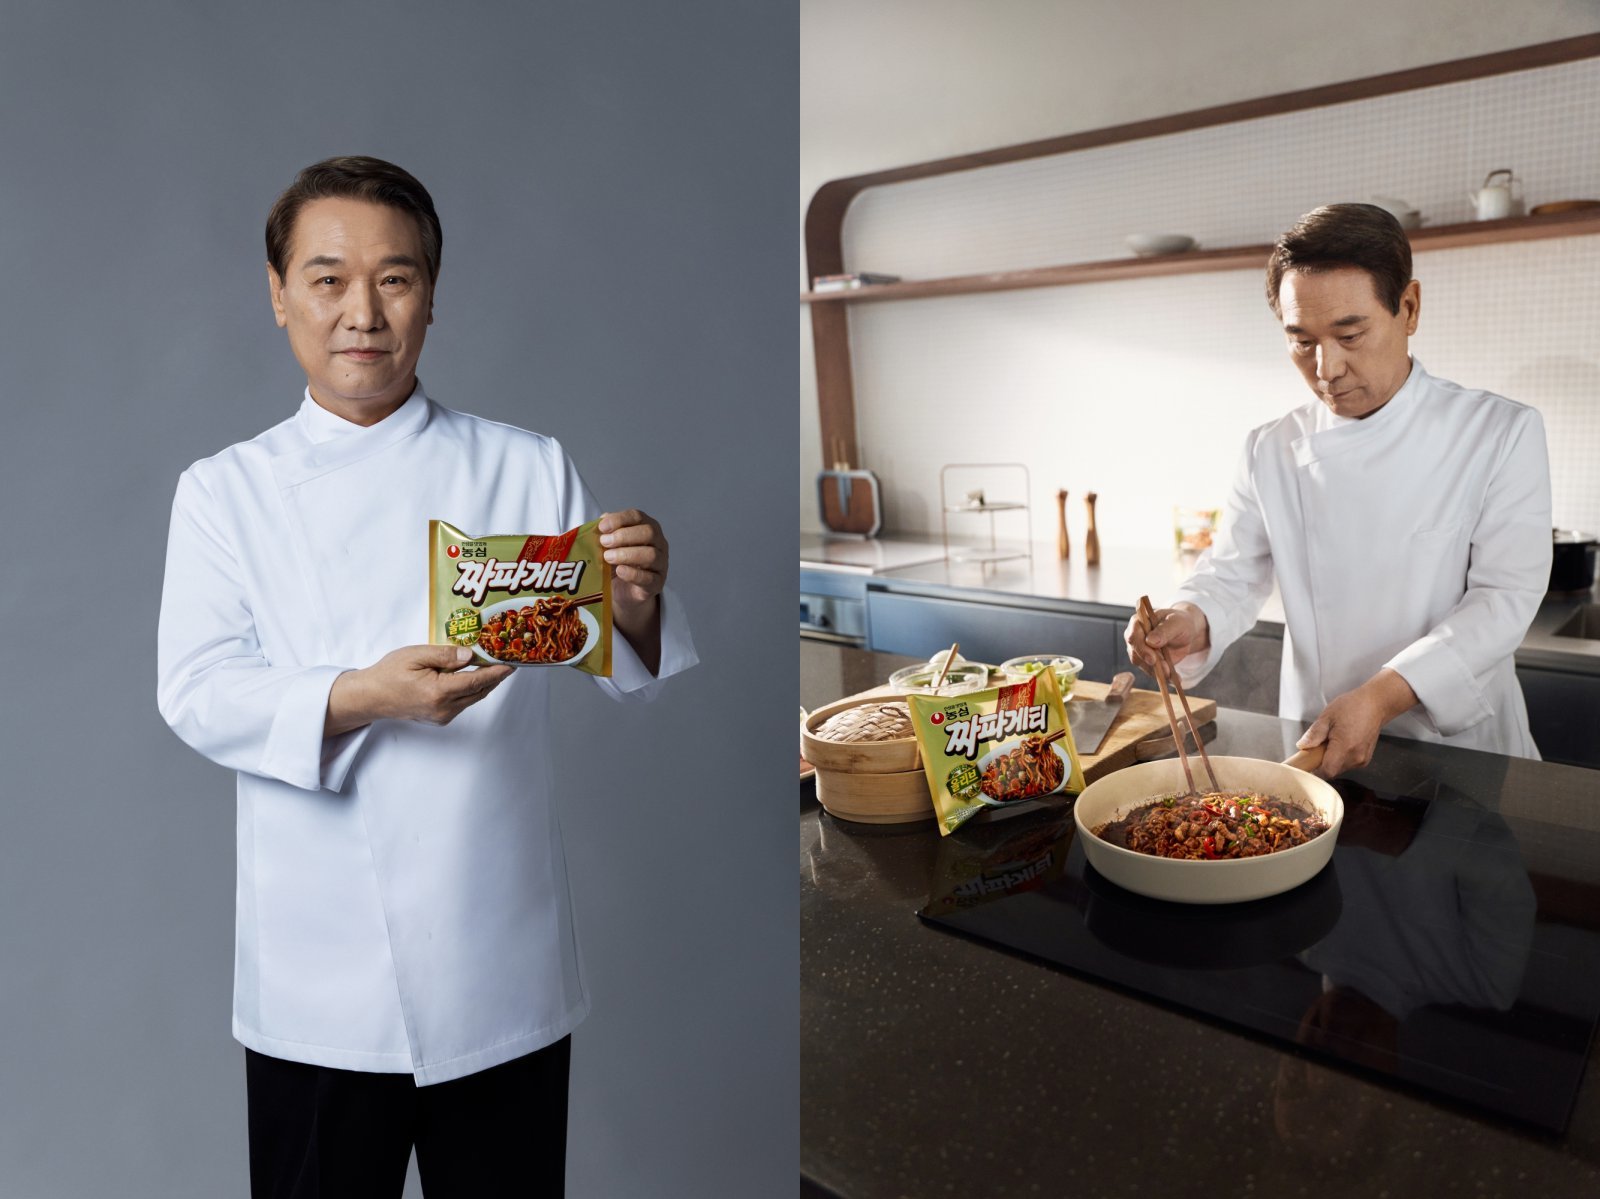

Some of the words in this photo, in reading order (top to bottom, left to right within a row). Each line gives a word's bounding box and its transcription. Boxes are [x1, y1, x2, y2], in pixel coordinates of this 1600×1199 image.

[461, 546, 487, 558] 농심
[452, 558, 586, 606] 짜파게티
[449, 616, 479, 636] 올리브
[945, 706, 969, 720] 농심
[944, 703, 1048, 759] 짜파게티
[950, 769, 979, 792] 올리브
